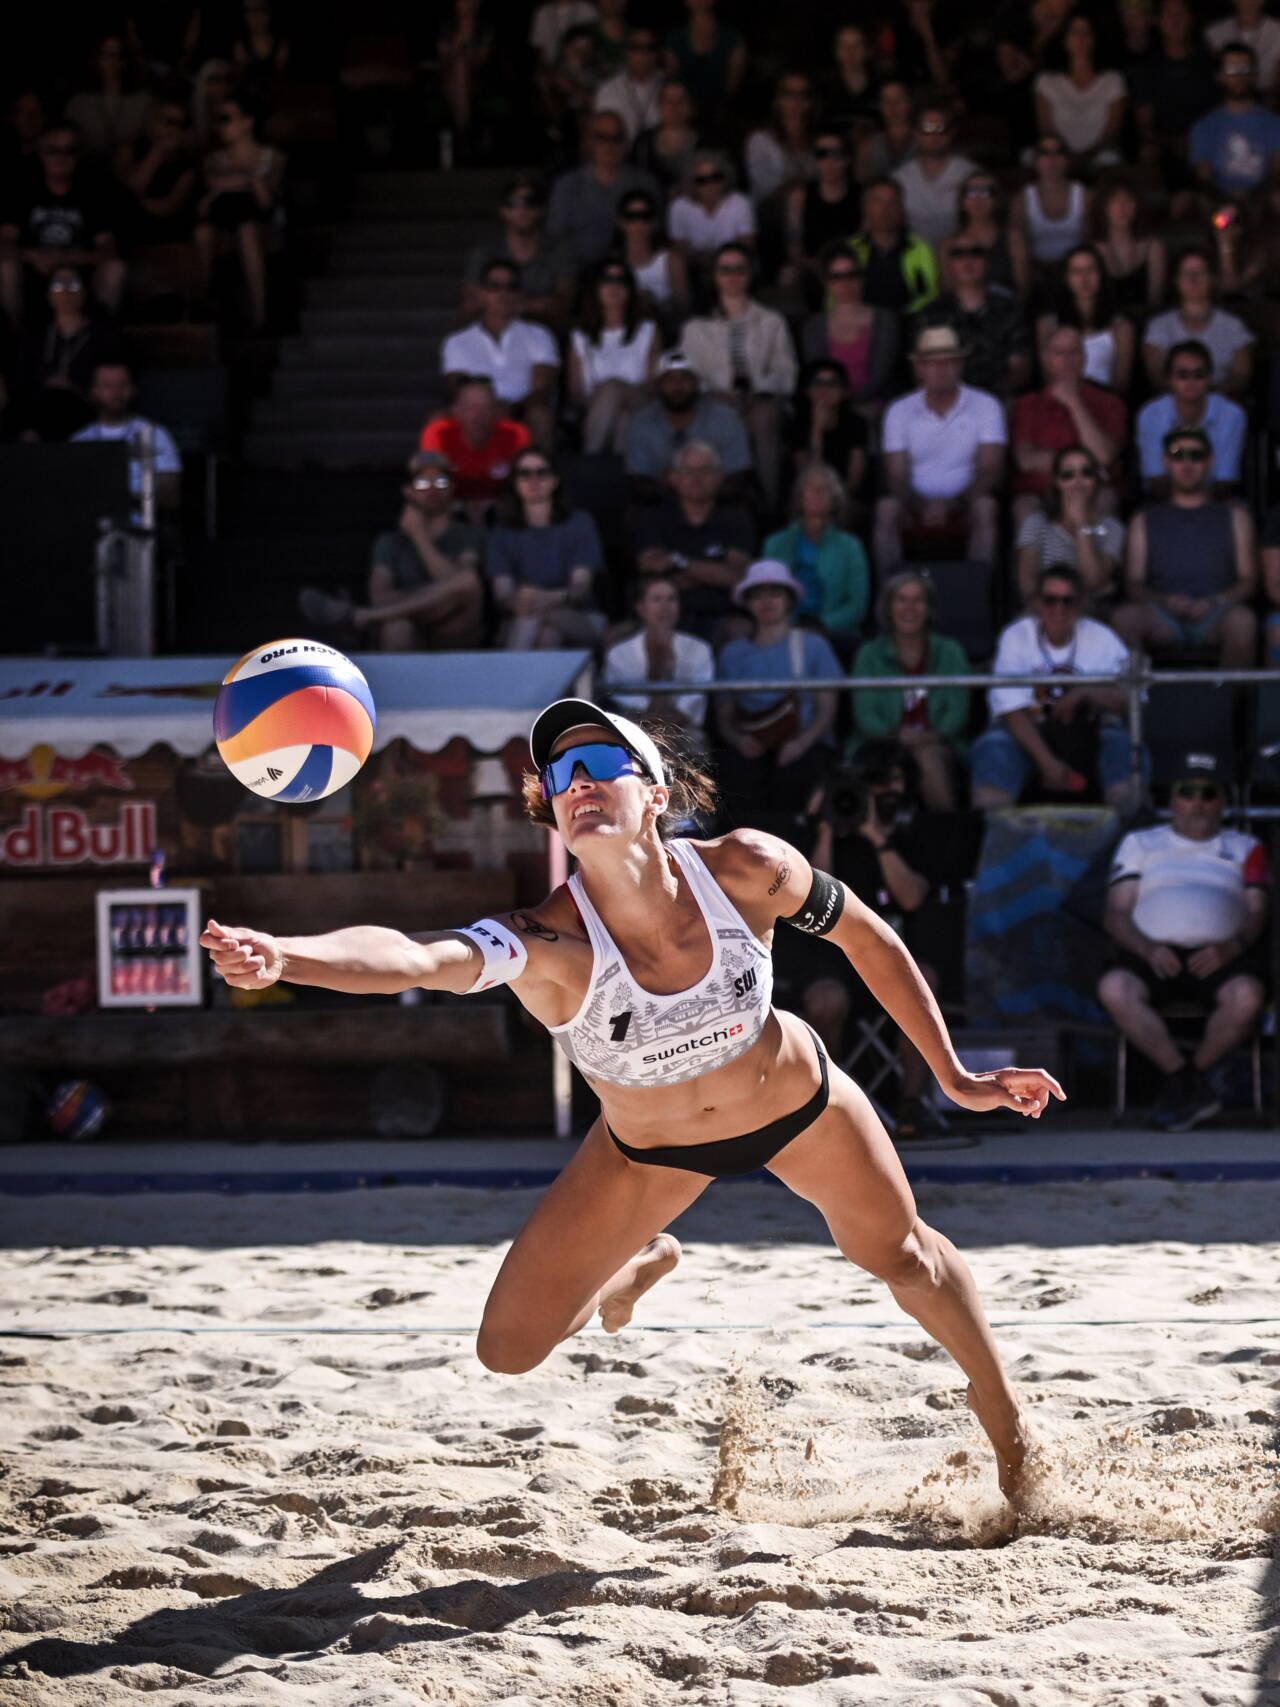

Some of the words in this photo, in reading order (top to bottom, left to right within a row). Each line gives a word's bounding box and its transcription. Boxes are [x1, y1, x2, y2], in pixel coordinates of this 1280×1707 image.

[260, 645, 298, 664] PRO
[304, 645, 353, 665] ACH
[50, 804, 155, 862] Bull
[768, 865, 789, 897] QUICK
[734, 967, 758, 998] SUI
[608, 1011, 632, 1042] 1
[642, 1028, 729, 1065] swatch
